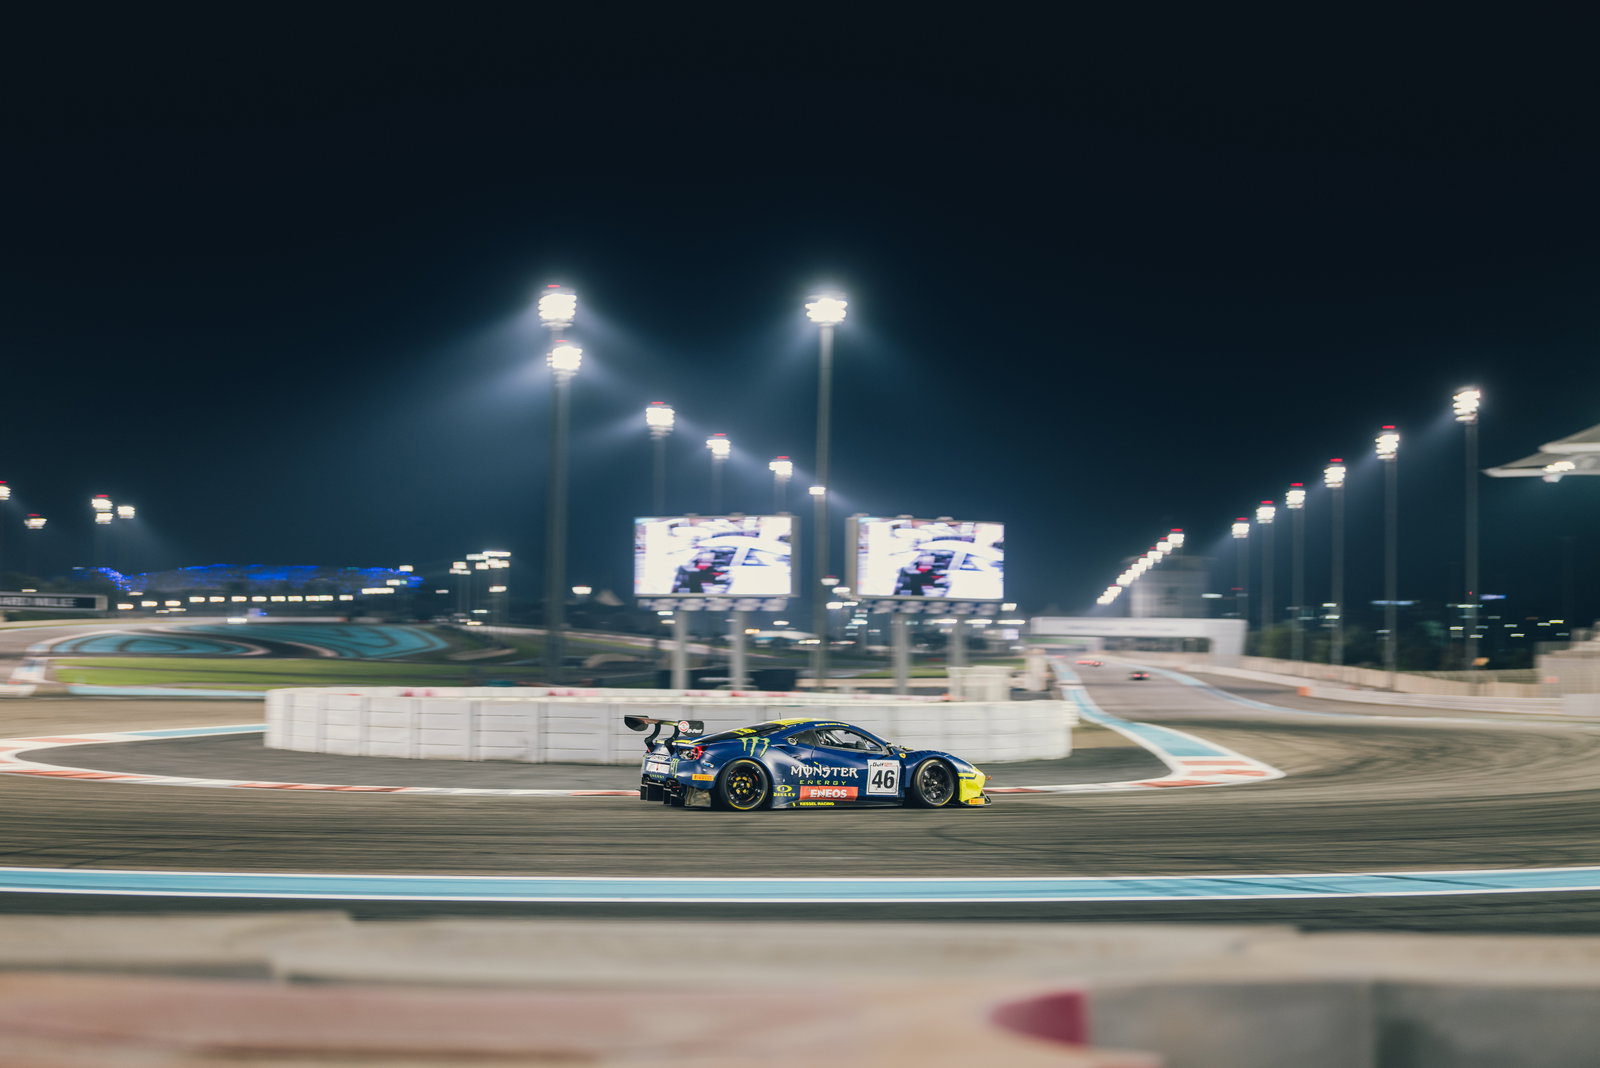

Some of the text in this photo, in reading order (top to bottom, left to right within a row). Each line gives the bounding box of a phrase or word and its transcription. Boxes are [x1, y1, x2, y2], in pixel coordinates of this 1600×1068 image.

[791, 764, 859, 779] MONSTER
[872, 770, 895, 788] 46
[810, 789, 847, 798] ENEOS
